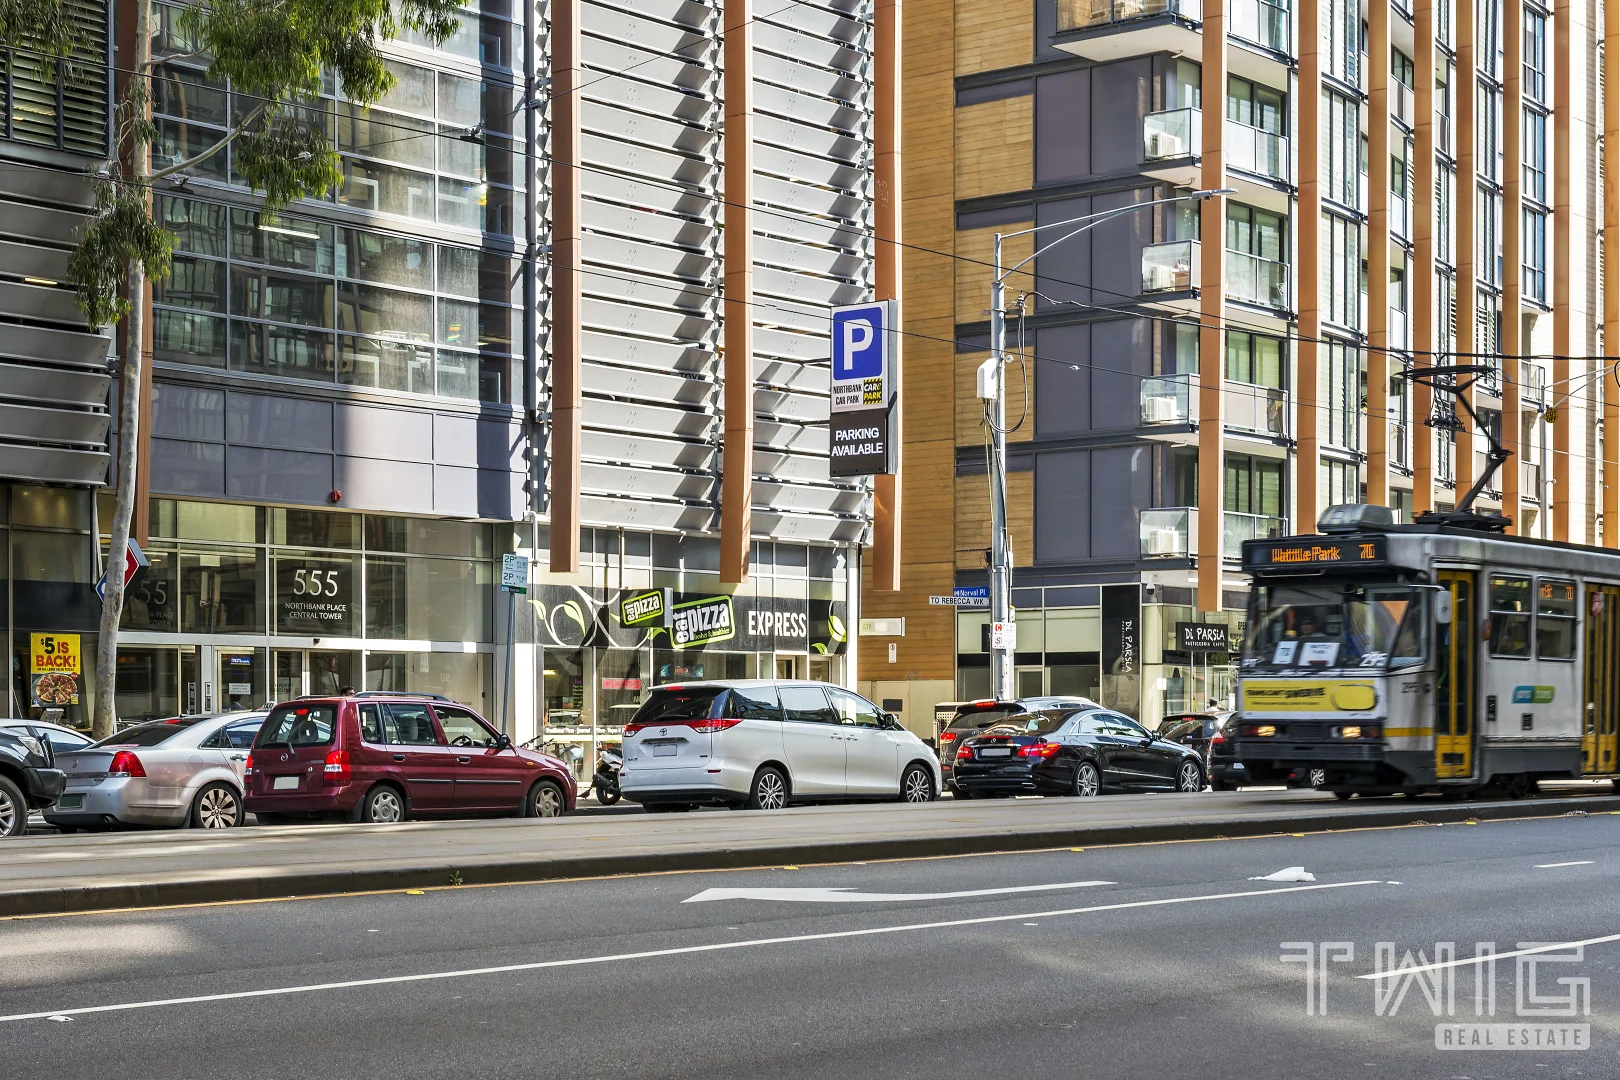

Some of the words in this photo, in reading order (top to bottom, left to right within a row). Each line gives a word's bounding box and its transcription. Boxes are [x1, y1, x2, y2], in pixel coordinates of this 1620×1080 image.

[843, 318, 874, 371] P
[833, 383, 862, 395] NORTHBANK
[863, 391, 882, 400] PARK
[835, 396, 846, 406] CAR
[847, 395, 860, 404] PARK
[835, 427, 880, 442] PARKING
[831, 442, 884, 457] AVAILABLE
[504, 555, 515, 564] 2P
[1271, 547, 1312, 563] Wattle
[1311, 546, 1341, 562] Park
[1358, 543, 1375, 559] 70
[293, 569, 338, 597] 555
[503, 572, 514, 581] 2P
[960, 589, 979, 597] Norval
[284, 602, 326, 611] NORTHBANK
[326, 603, 347, 611] PLACE
[930, 596, 940, 604] TO
[941, 597, 971, 605] REBECCA
[625, 603, 635, 621] eat
[633, 595, 660, 619] pizza
[289, 611, 318, 619] CENTRAL
[319, 612, 343, 620] TOWER
[672, 611, 690, 643] eat
[687, 603, 730, 641] pizza
[748, 610, 807, 638] EXPRESS
[57, 641, 70, 654] IS
[35, 655, 77, 668] BACK!
[1360, 651, 1388, 667] 295
